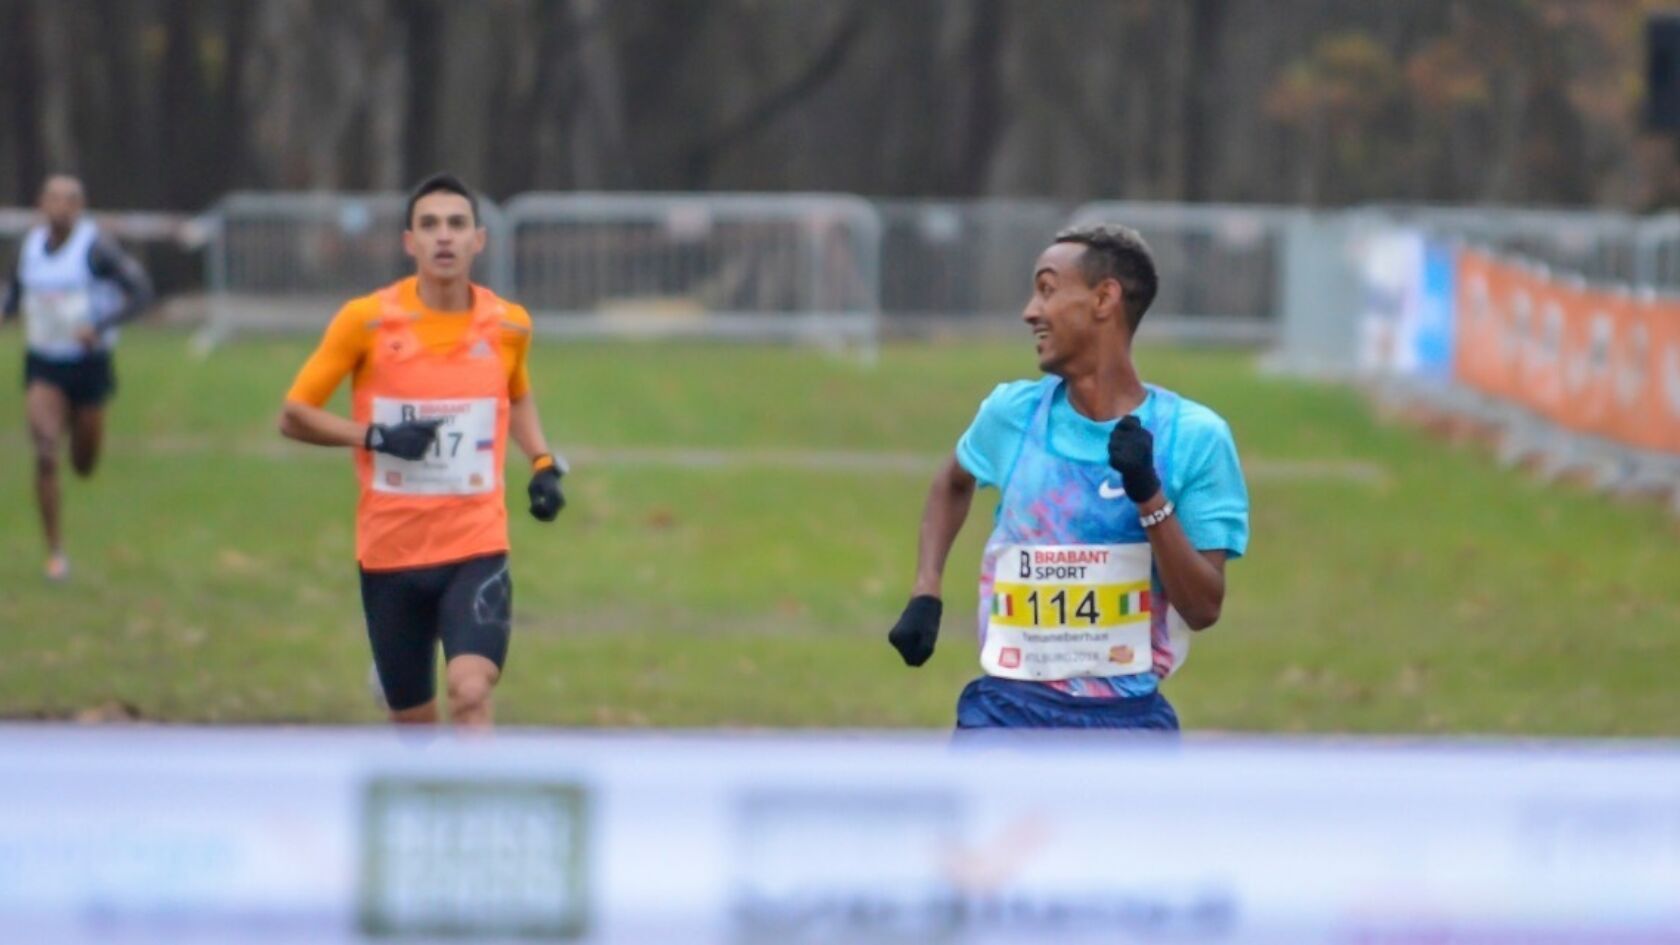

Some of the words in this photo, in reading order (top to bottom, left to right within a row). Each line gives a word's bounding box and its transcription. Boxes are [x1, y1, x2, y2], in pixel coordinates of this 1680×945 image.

[1019, 550, 1031, 578] B
[1034, 551, 1109, 564] BRABANT
[1035, 566, 1087, 579] SPORT
[1027, 590, 1100, 625] 114
